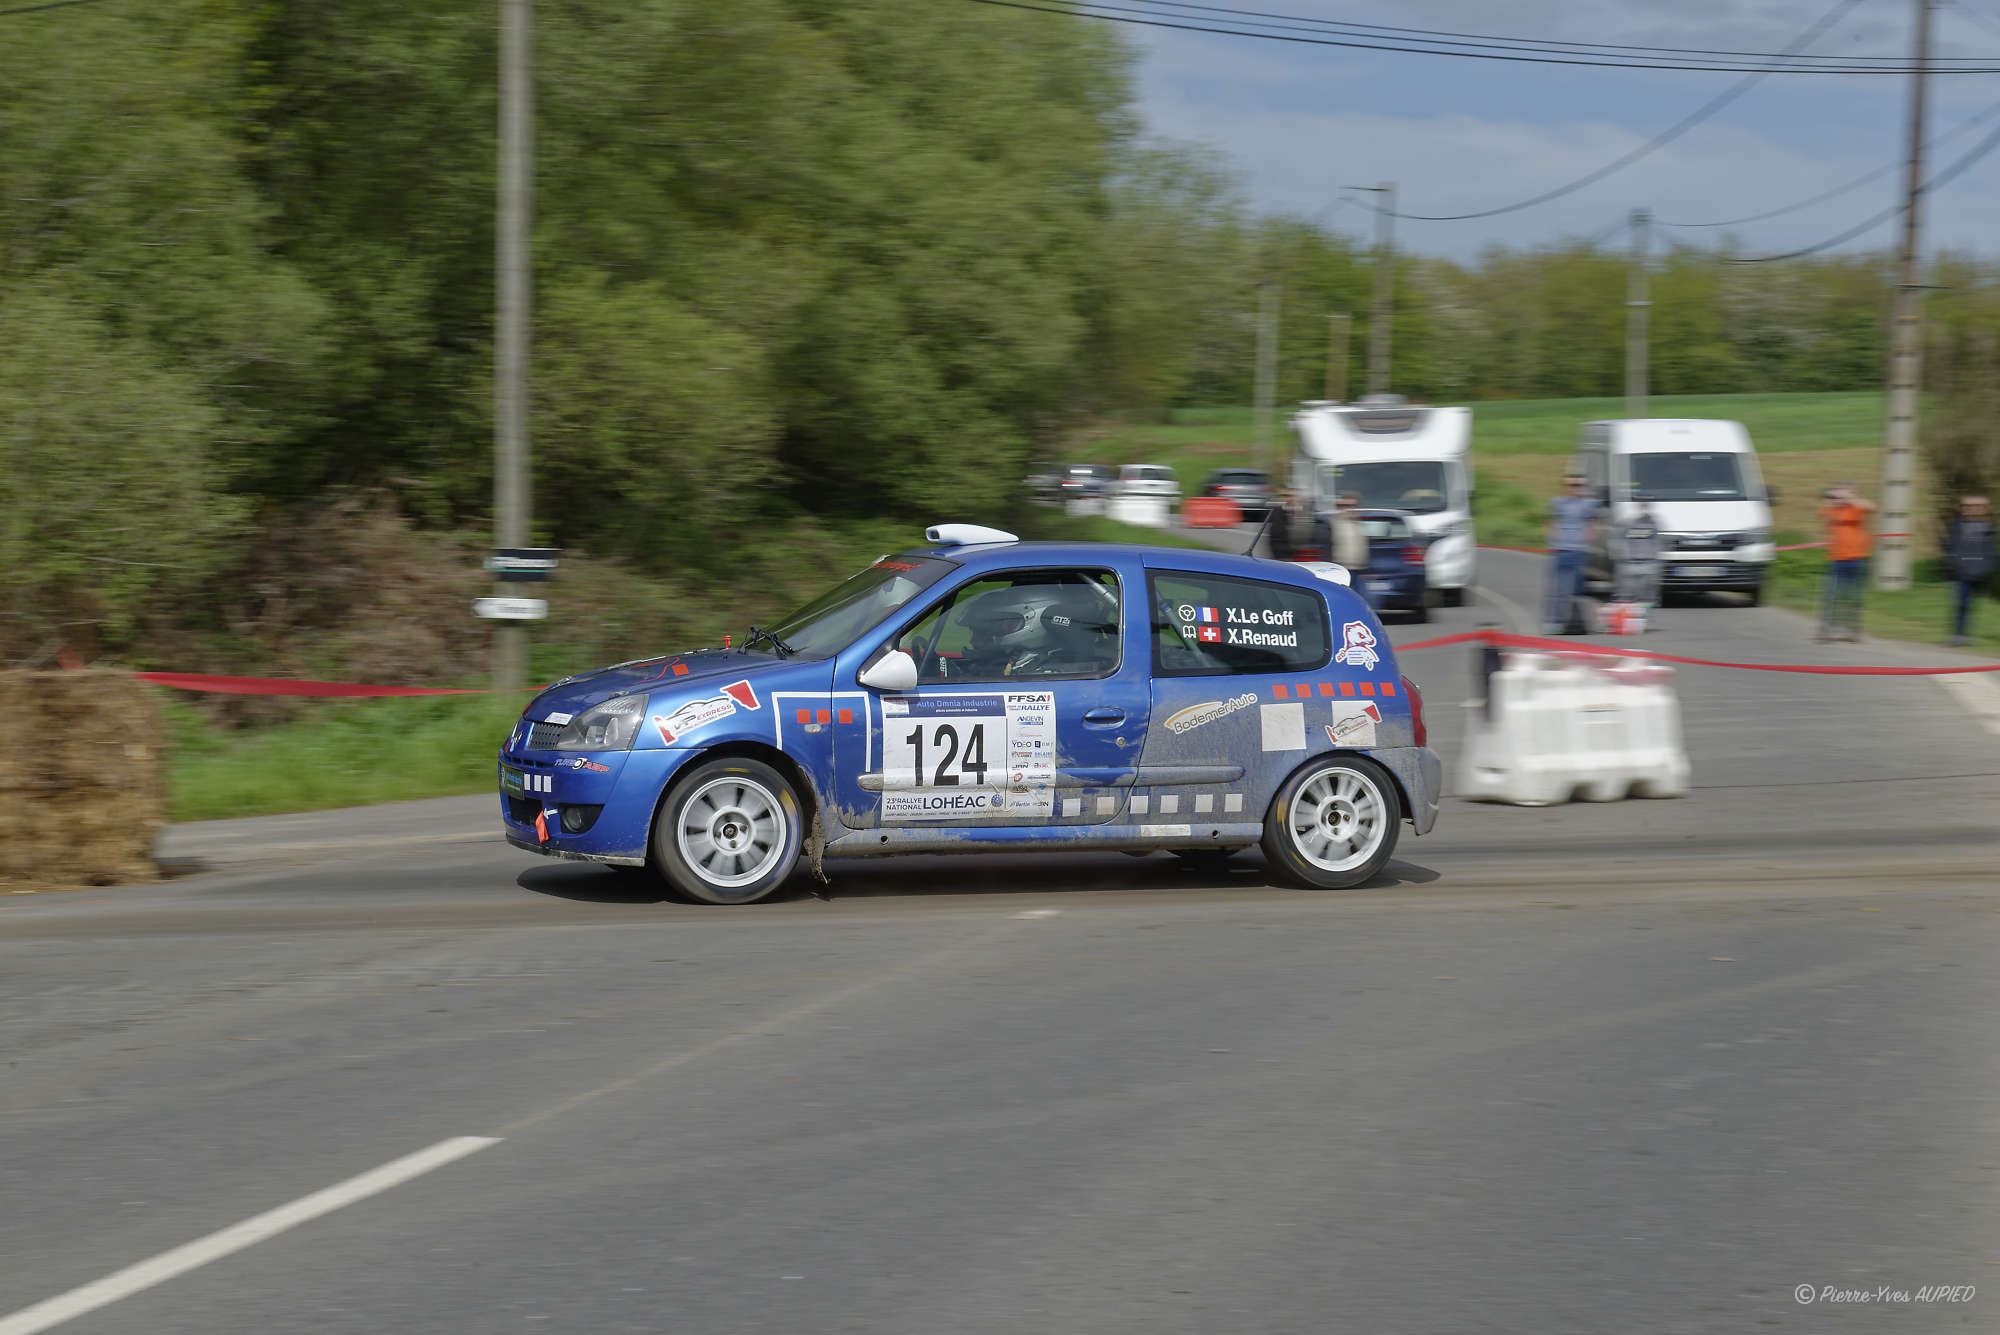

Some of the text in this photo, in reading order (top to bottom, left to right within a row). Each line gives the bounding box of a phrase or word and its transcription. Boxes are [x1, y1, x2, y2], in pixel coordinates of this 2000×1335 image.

[1262, 609, 1294, 626] Goff
[1227, 628, 1298, 647] X.Renaud
[906, 723, 988, 786] 124
[923, 794, 986, 810] LOHÉAC
